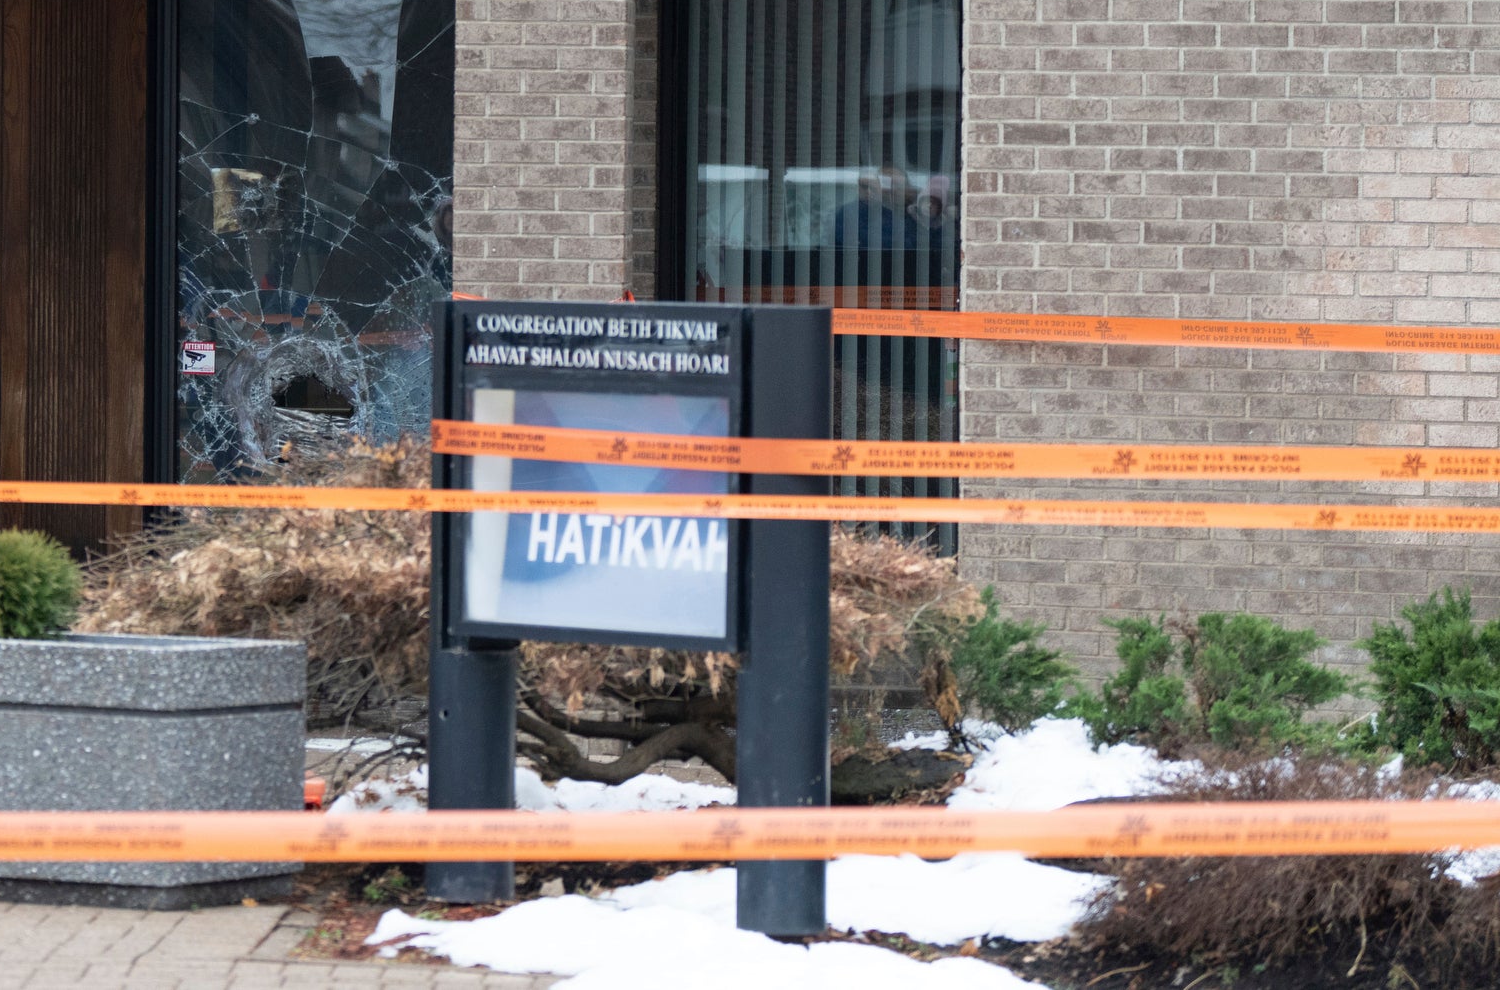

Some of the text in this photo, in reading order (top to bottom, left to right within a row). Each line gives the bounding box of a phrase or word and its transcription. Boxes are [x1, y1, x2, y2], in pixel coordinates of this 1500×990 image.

[476, 313, 718, 341] CONGREGATION BETH TIKVAH
[466, 345, 729, 374] AHAVAT SHALOM NUSACH HOARI
